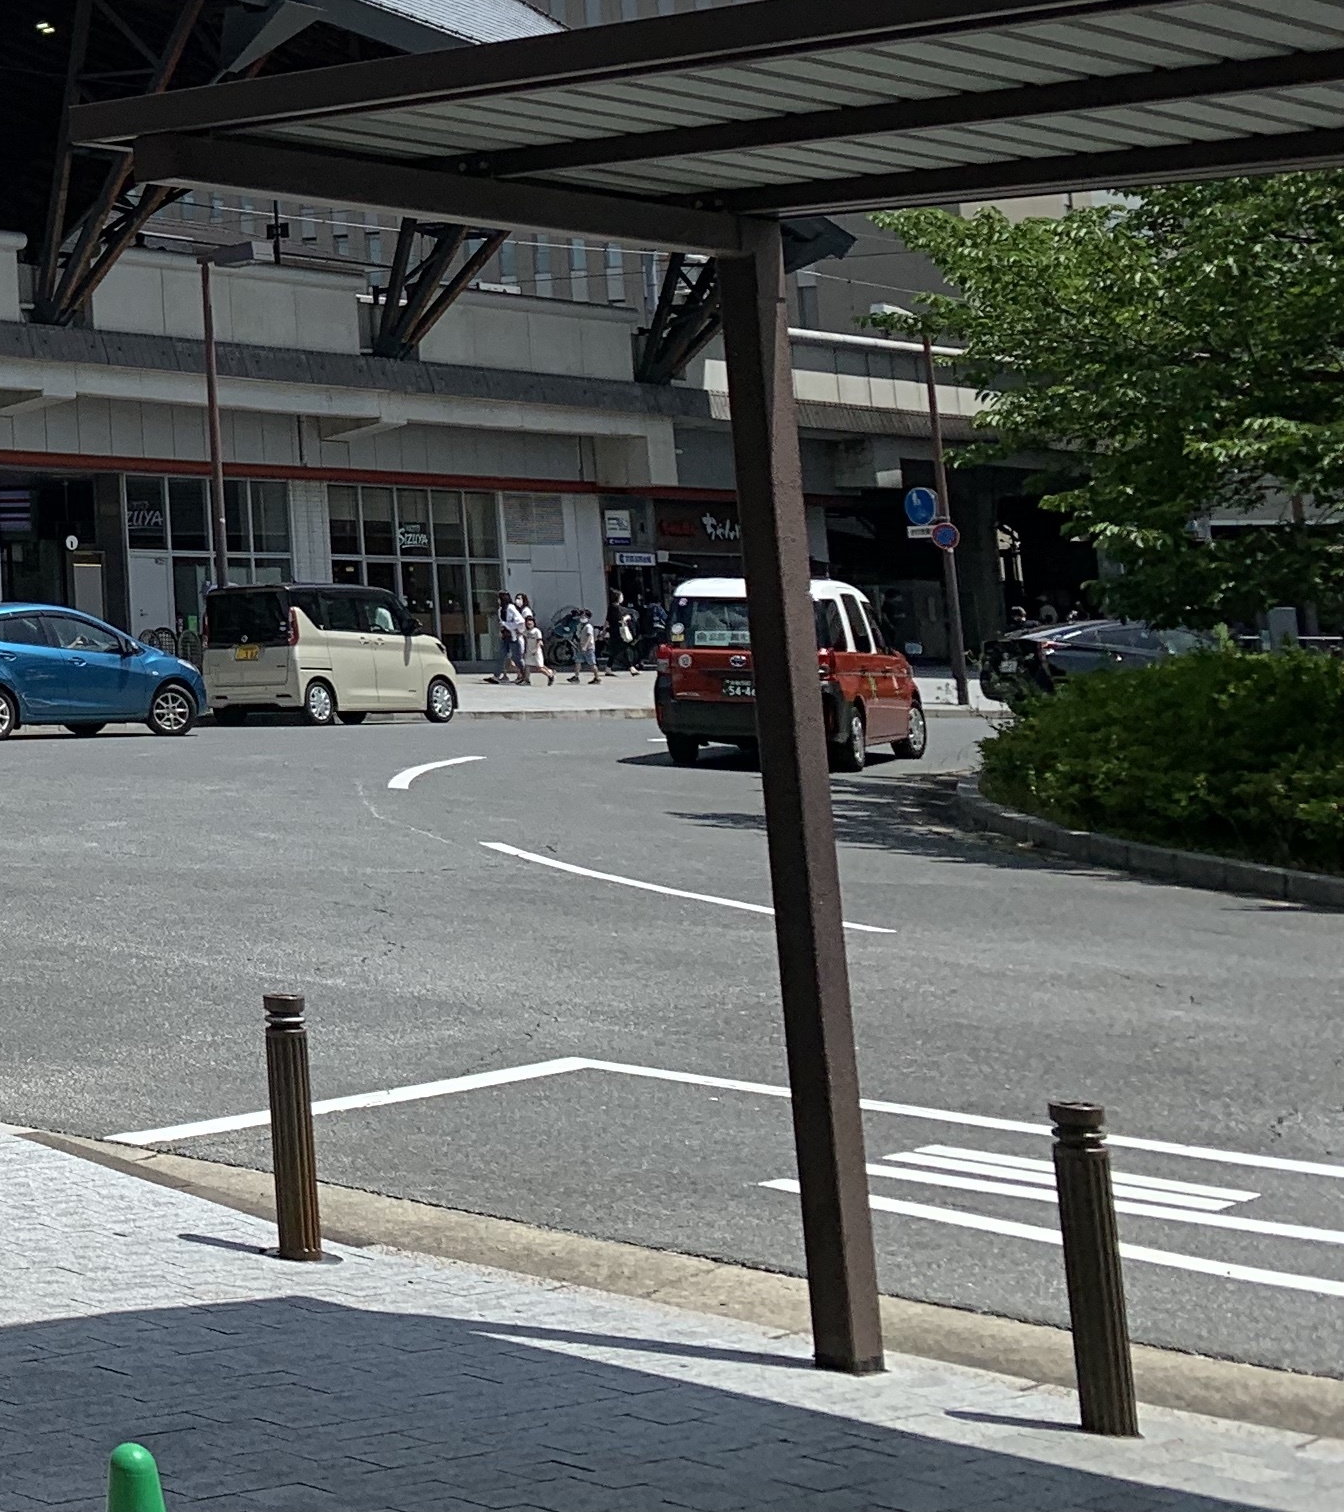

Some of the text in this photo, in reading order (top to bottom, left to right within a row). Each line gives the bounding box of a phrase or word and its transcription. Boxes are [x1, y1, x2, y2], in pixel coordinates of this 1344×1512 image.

[127, 510, 163, 527] ZUYA
[701, 512, 741, 541] ちゃん
